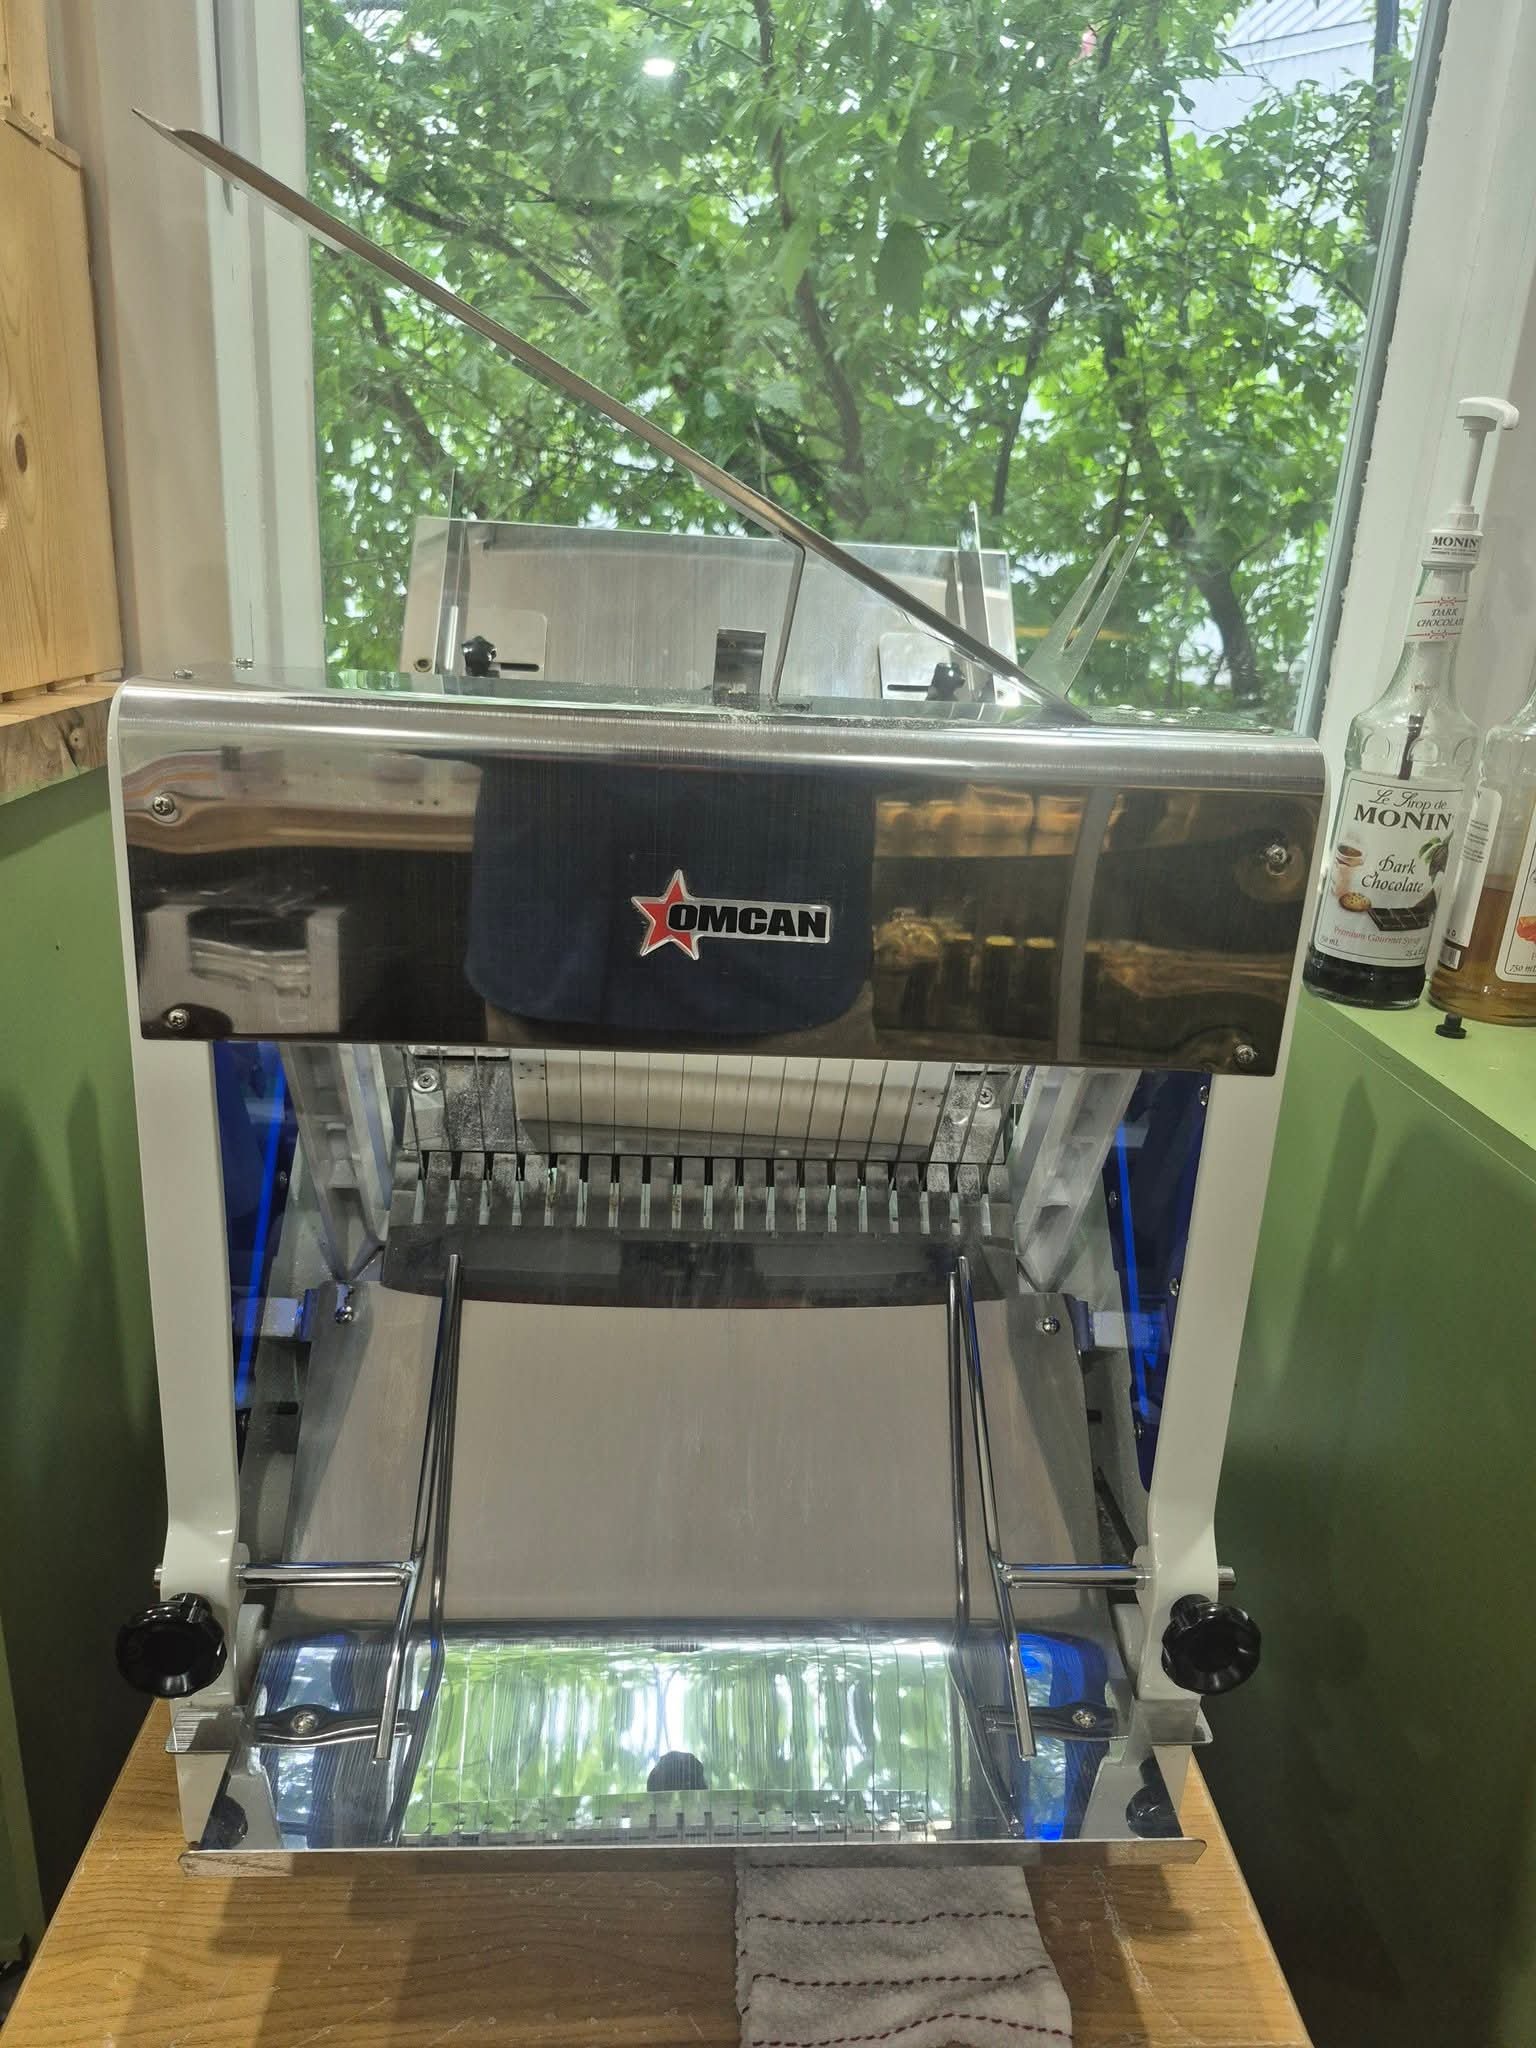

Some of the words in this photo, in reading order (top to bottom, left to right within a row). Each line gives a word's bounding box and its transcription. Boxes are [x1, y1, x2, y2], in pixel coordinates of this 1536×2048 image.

[1432, 536, 1477, 548] MONIN
[1431, 607, 1458, 616] DARK
[1368, 789, 1394, 804] Le
[1393, 791, 1431, 814] Sirop
[1433, 800, 1448, 810] de
[1353, 803, 1452, 831] MONIN
[1378, 854, 1416, 875] Dark
[1361, 871, 1424, 893] Chocolate
[668, 903, 827, 939] OMCAN
[1509, 964, 1524, 973] 750
